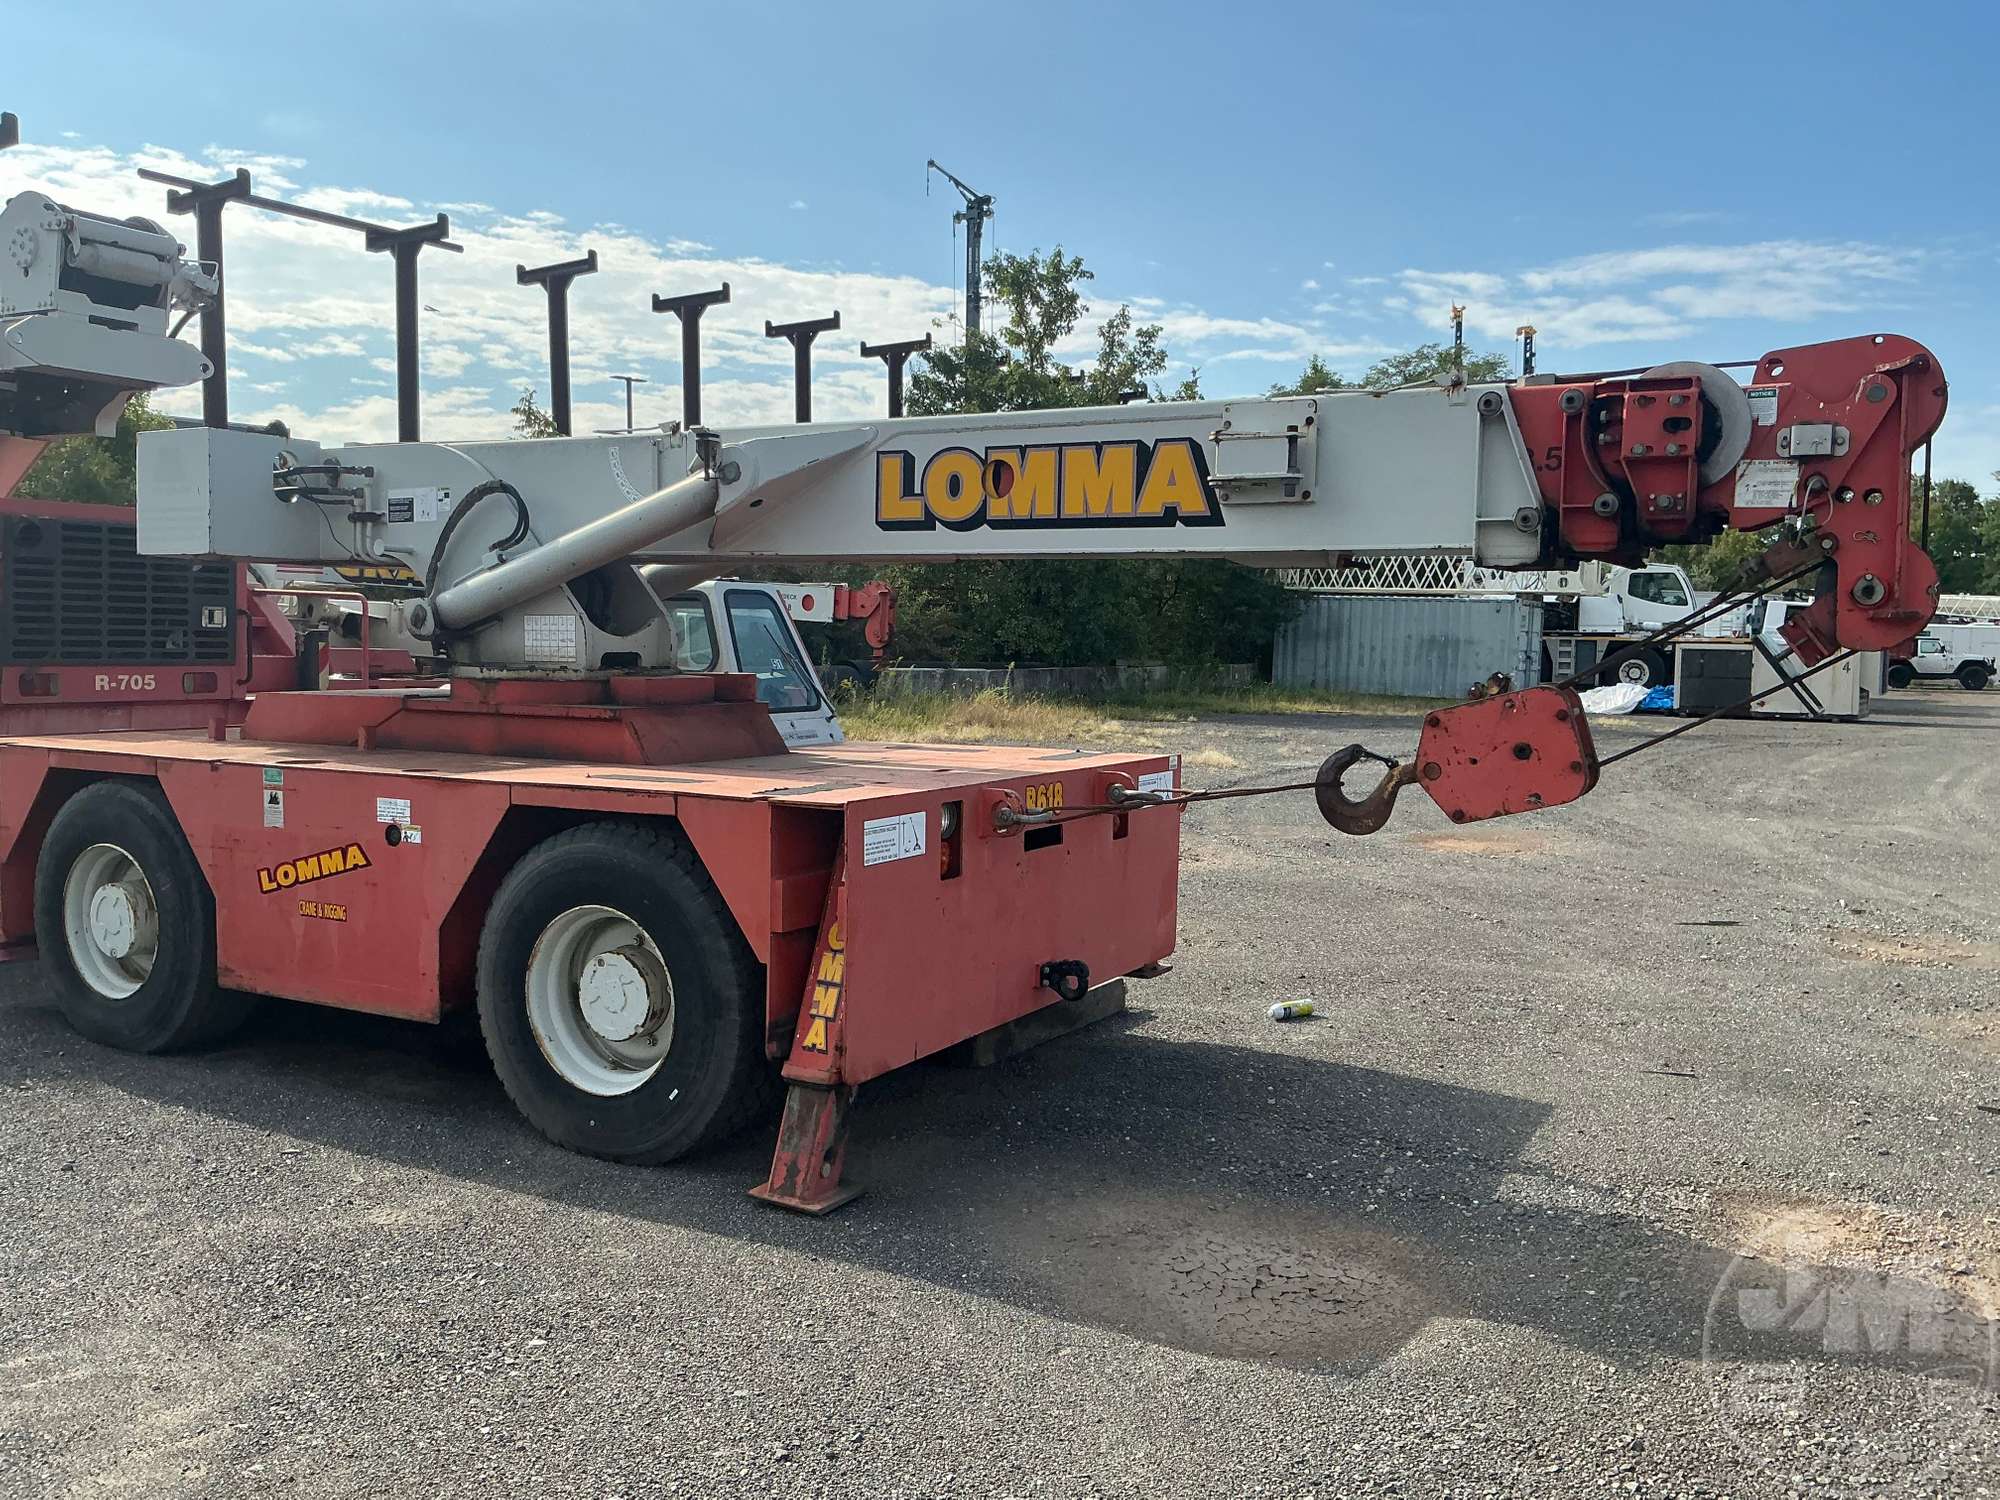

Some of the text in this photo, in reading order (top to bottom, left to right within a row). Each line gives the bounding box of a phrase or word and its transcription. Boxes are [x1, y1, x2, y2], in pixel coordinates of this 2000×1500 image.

[876, 437, 1225, 532] LOMMA
[1842, 661, 1851, 674] 4
[95, 674, 156, 691] R-705
[258, 844, 371, 893] LOMMA
[299, 900, 317, 917] CRANE
[324, 903, 347, 921] RIGGING
